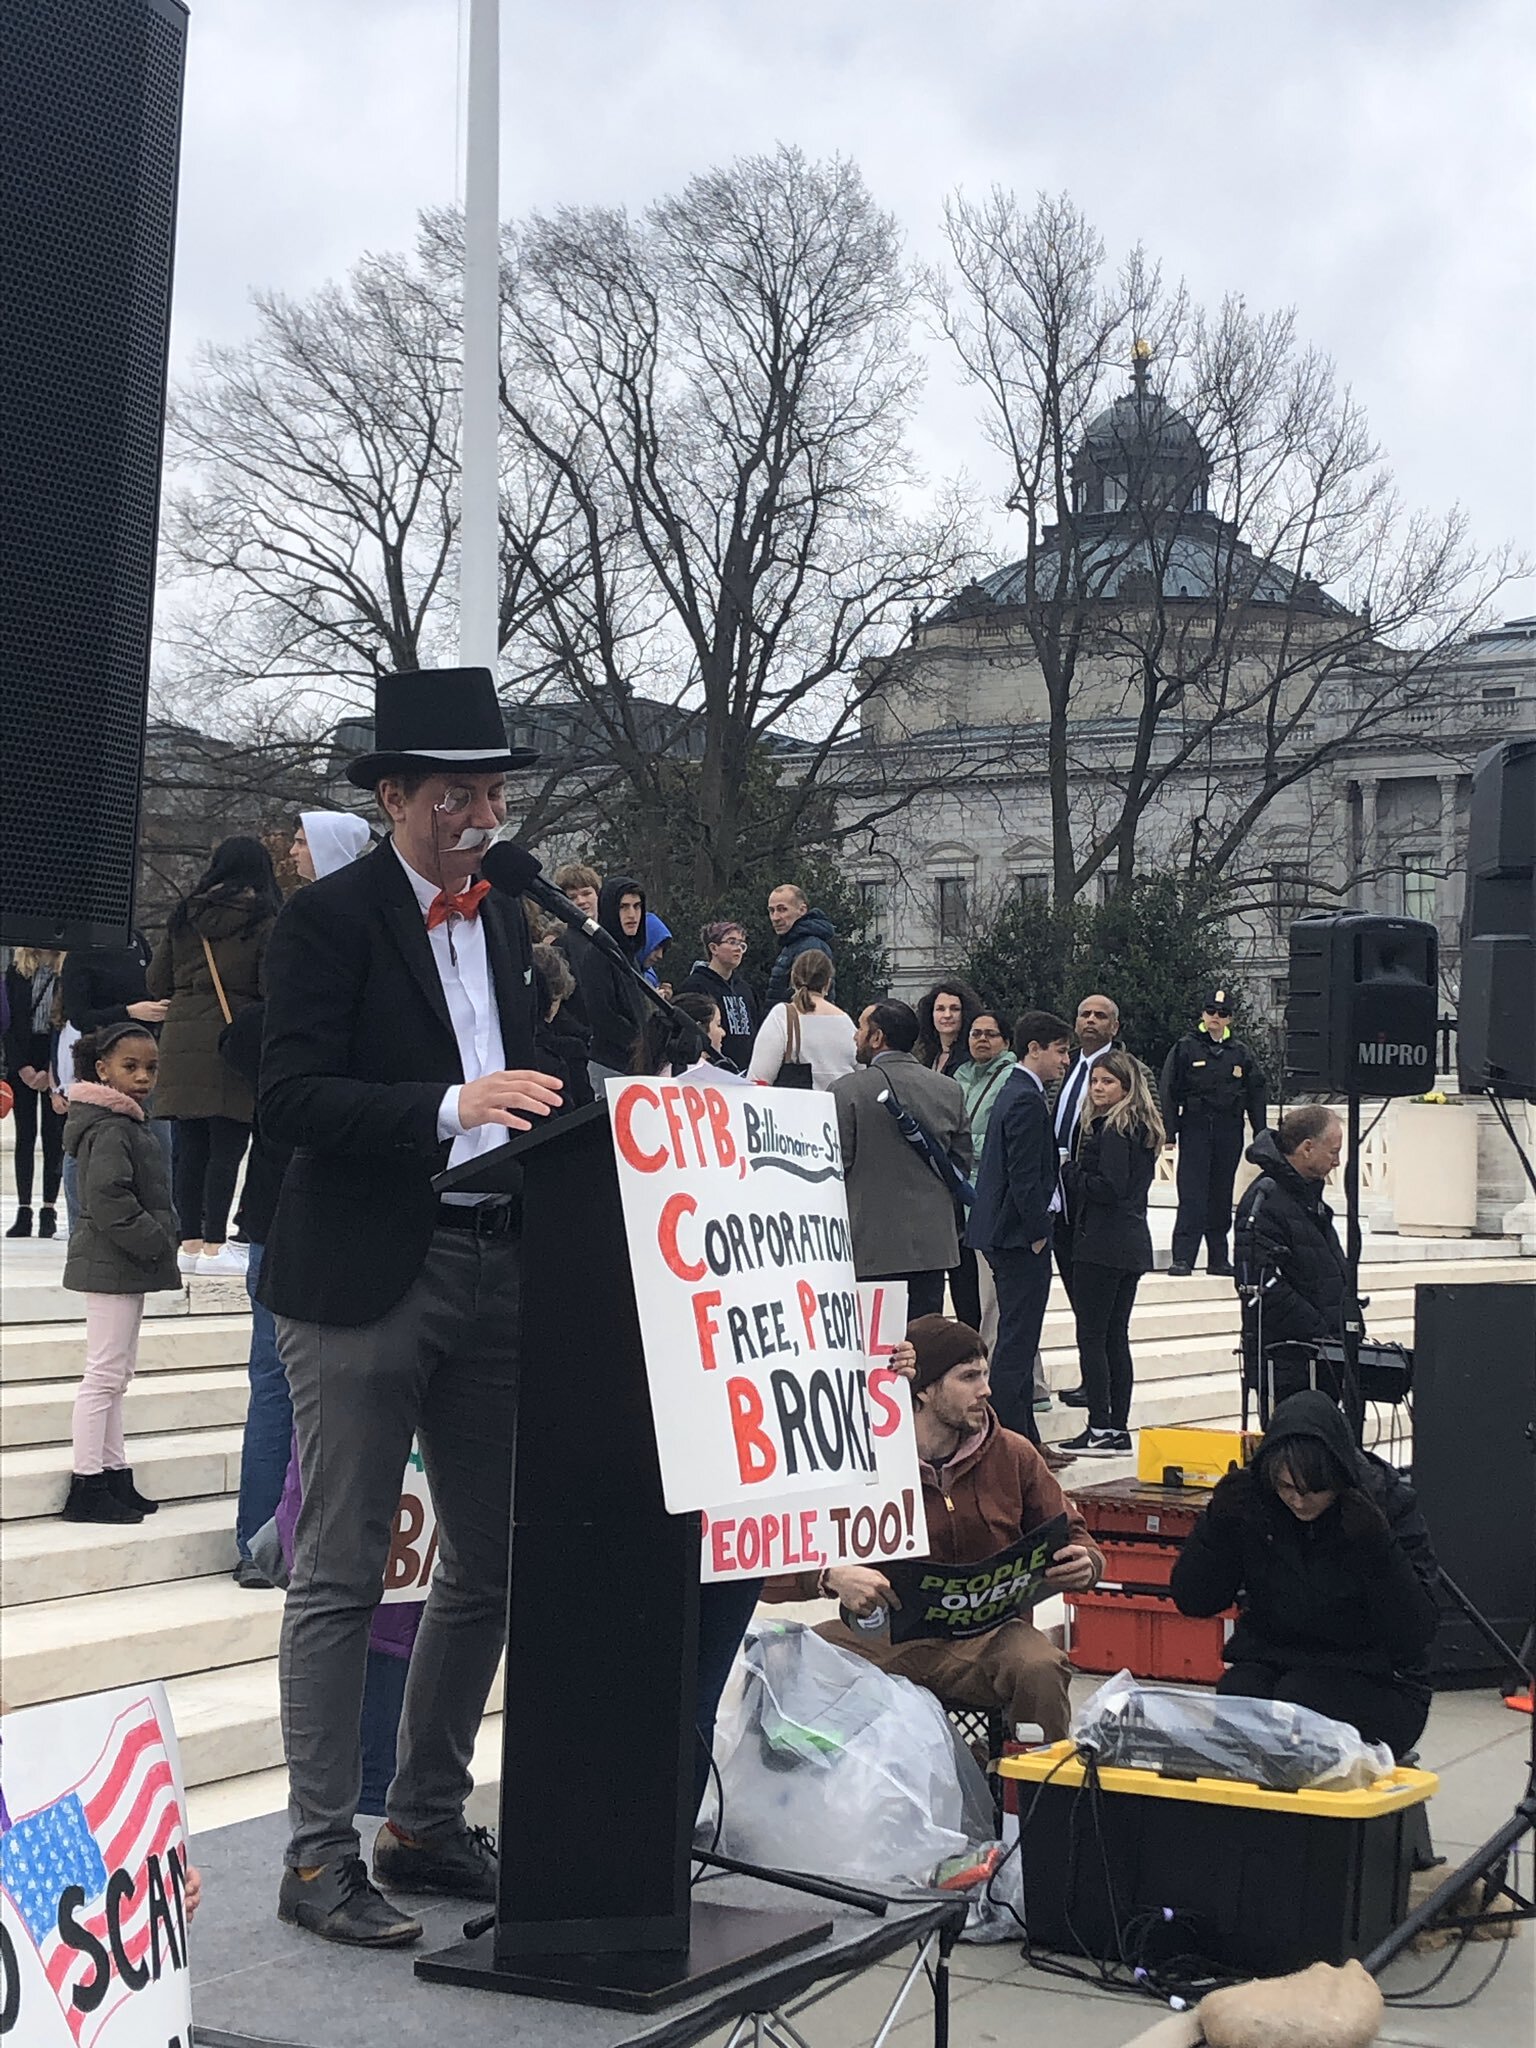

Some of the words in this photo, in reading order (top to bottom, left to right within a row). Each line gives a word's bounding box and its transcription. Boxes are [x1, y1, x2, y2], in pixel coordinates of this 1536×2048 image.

[1359, 1042, 1428, 1066] MIPRO
[614, 1084, 747, 1180] CFPB,
[691, 1289, 800, 1372] FREE,
[829, 1489, 915, 1560] TOO!
[919, 1541, 1049, 1594] PEOPLE
[940, 1573, 1032, 1611] OVER
